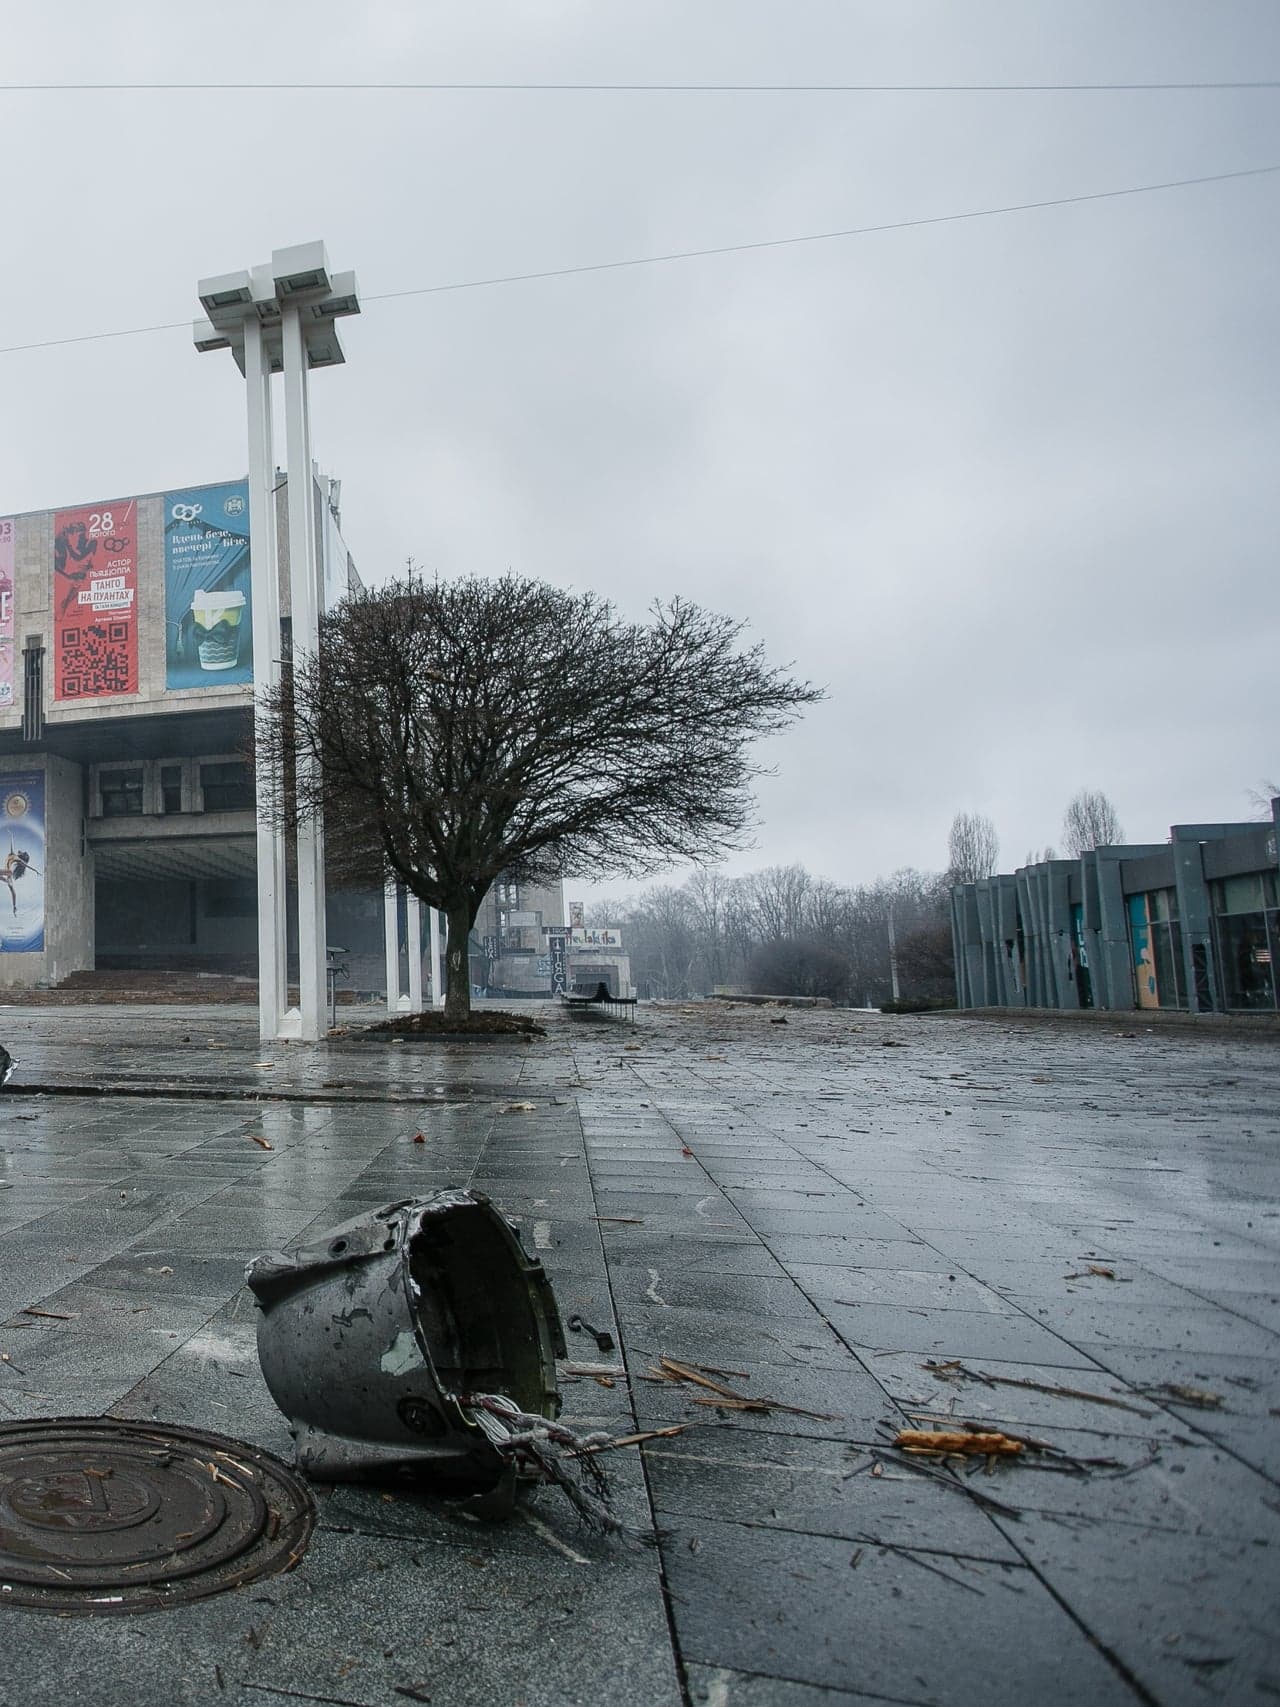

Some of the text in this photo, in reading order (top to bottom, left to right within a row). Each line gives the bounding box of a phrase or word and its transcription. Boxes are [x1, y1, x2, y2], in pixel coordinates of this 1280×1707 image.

[89, 512, 114, 533] 28
[95, 579, 121, 590] ТАНГО
[80, 591, 130, 602] НА ПУАНТАХ
